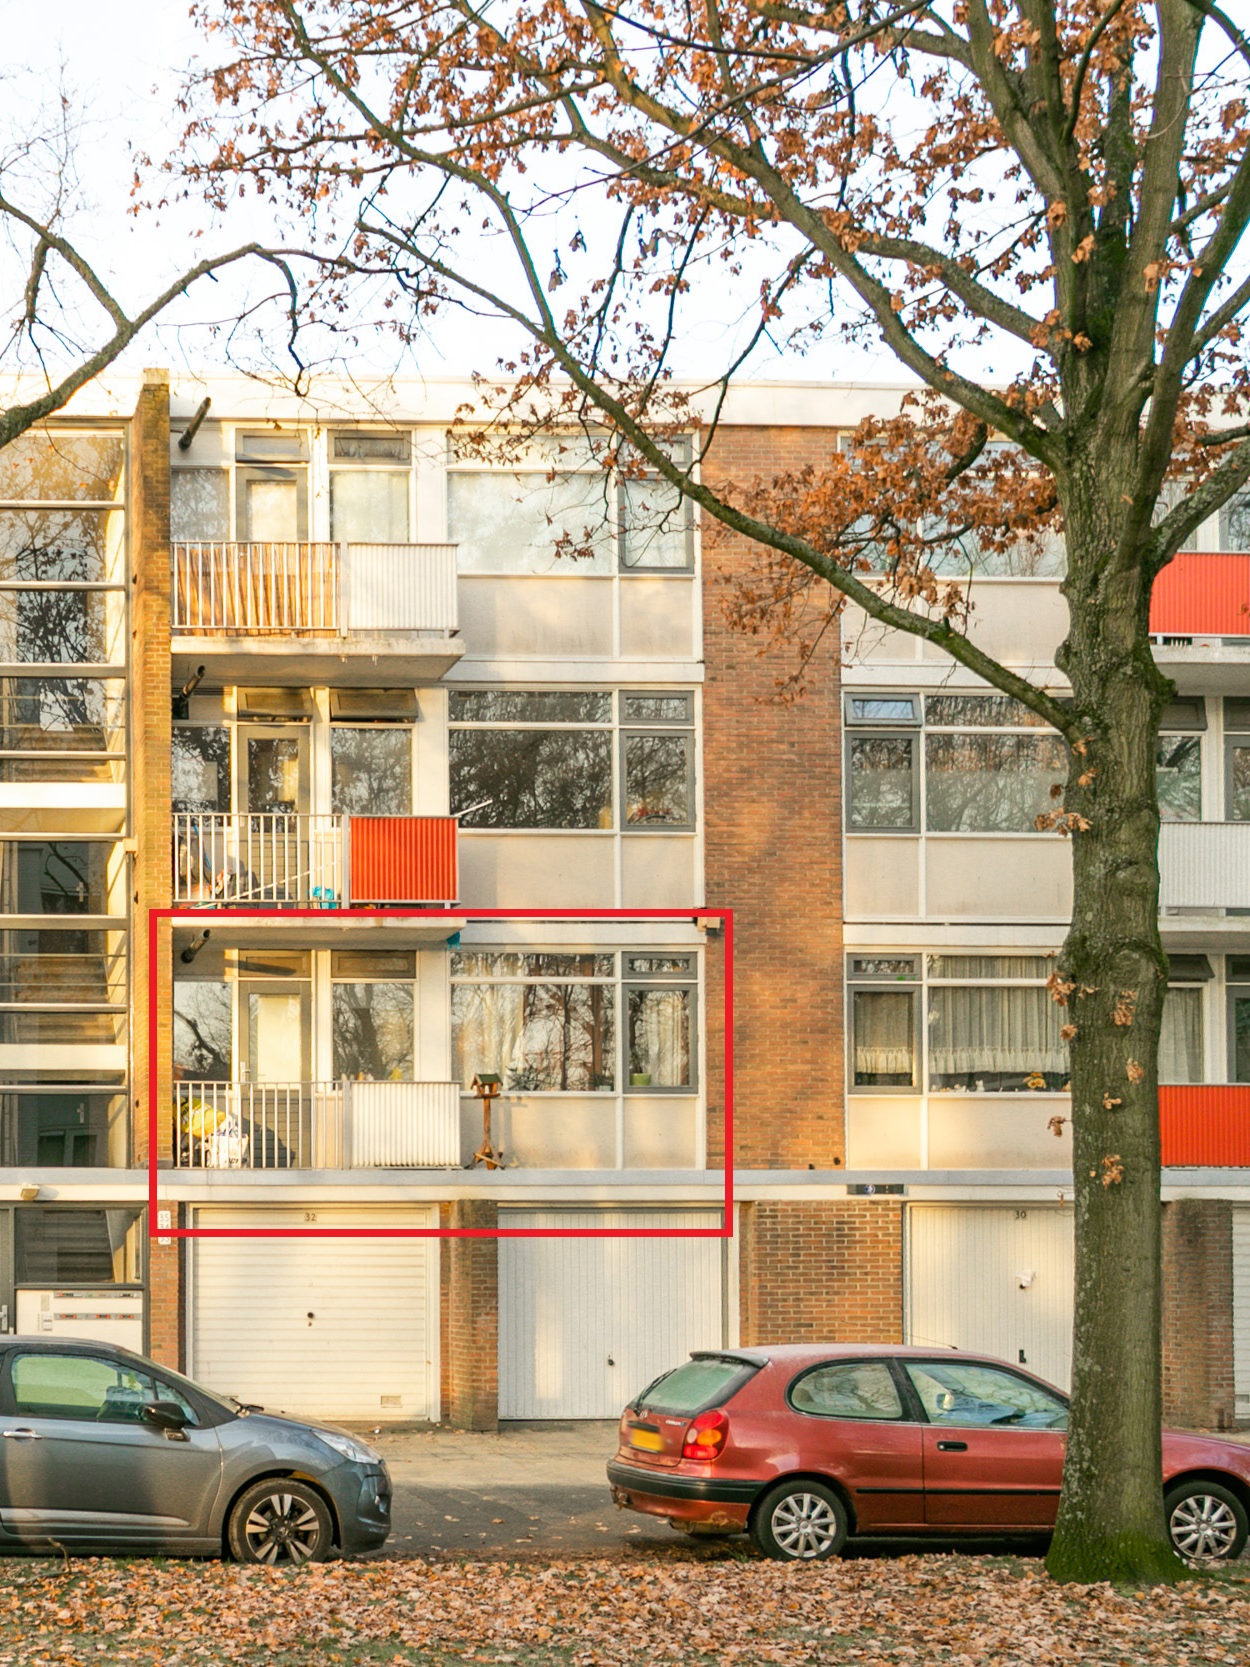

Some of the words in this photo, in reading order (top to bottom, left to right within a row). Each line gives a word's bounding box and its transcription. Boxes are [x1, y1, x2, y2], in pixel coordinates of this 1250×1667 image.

[160, 1213, 169, 1222] 35
[305, 1212, 316, 1222] 32
[1015, 1210, 1026, 1219] 30
